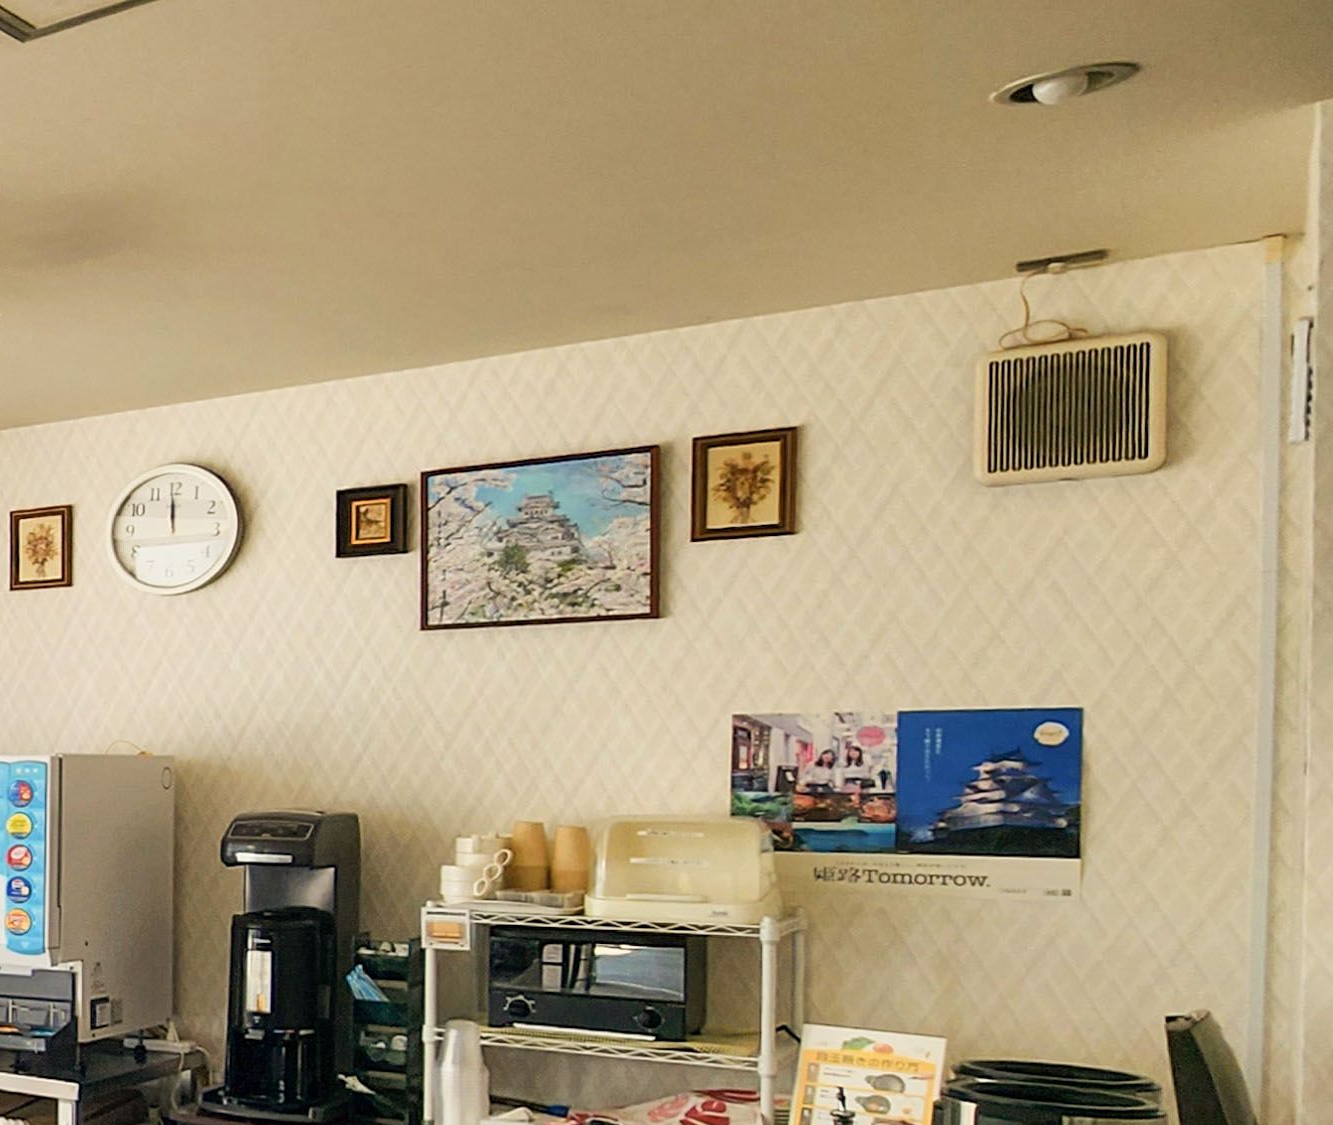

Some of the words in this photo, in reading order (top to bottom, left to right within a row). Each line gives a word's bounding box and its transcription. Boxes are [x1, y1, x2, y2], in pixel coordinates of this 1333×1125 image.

[150, 488, 161, 501] 11
[170, 482, 183, 497] 12
[194, 486, 200, 500] 1
[132, 503, 146, 517] 10
[207, 500, 216, 514] 2
[126, 524, 135, 537] 9
[212, 522, 221, 537] 3
